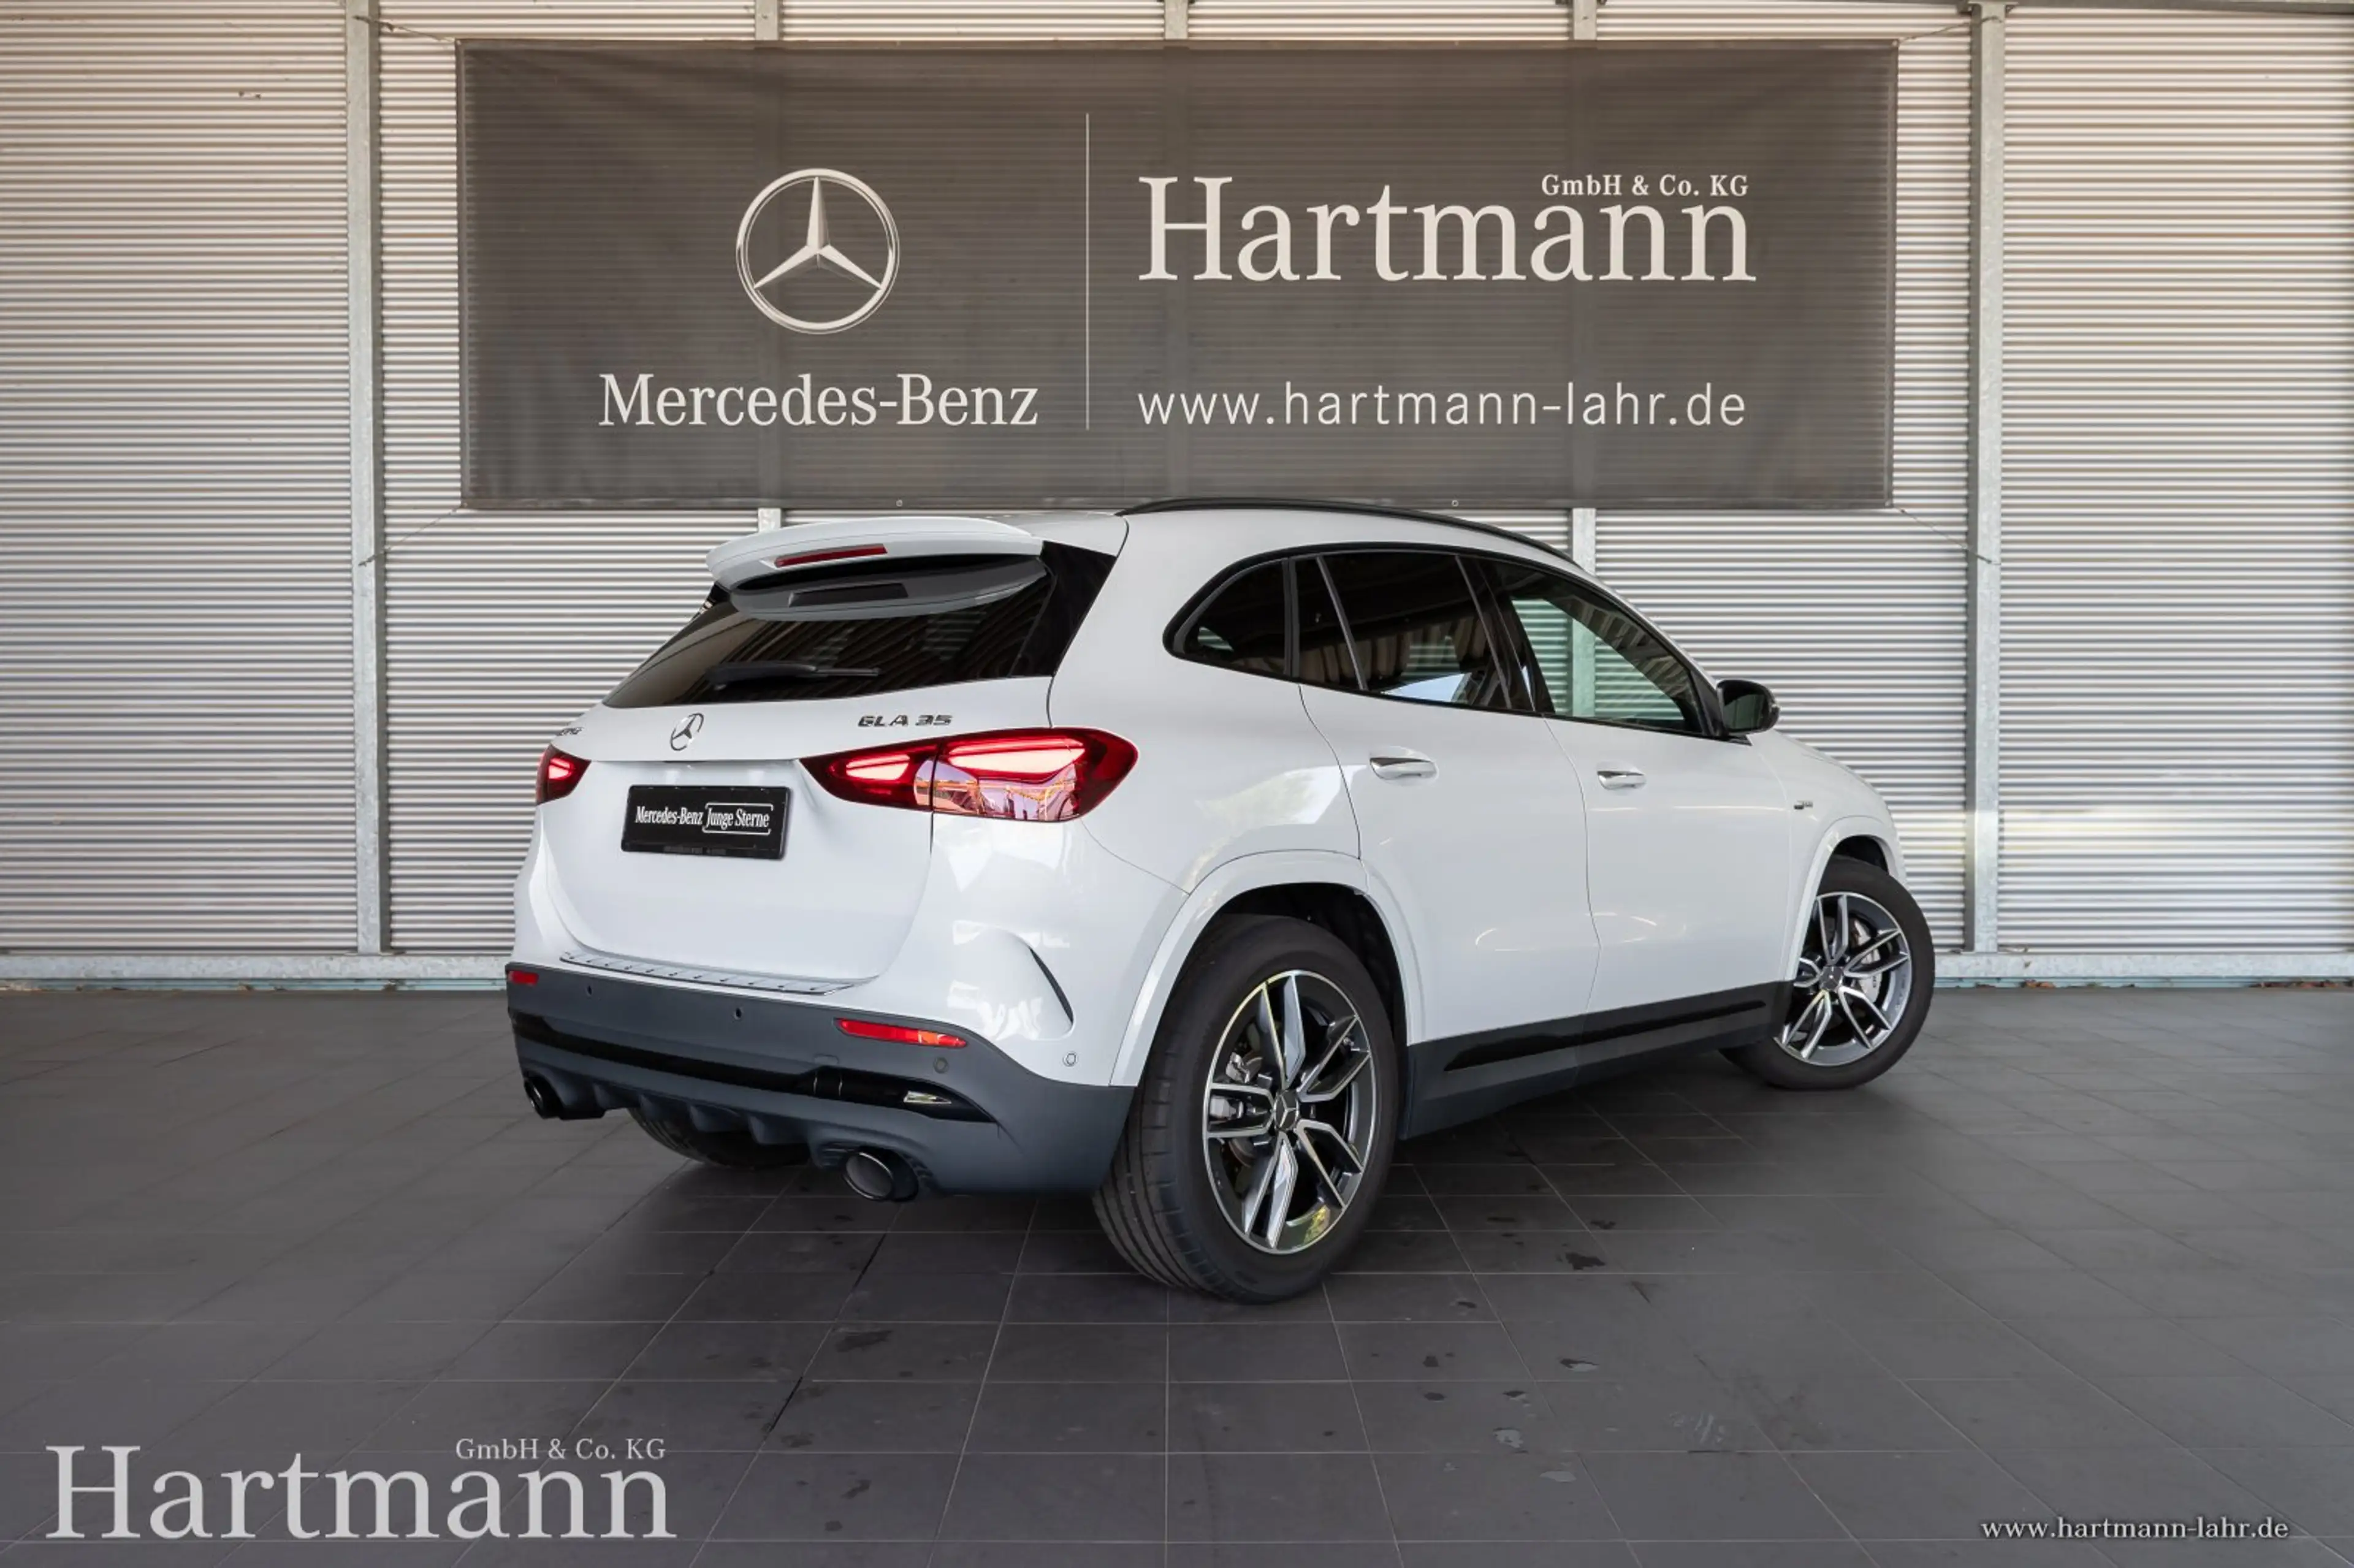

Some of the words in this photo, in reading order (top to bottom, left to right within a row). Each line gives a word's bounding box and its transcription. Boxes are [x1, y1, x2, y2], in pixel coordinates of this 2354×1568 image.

[1541, 174, 1622, 196] GmbH
[1632, 174, 1649, 196] &
[1659, 174, 1700, 197] Co.
[1710, 174, 1748, 197] KG
[1138, 176, 1757, 282] Hartmann
[598, 373, 1038, 426] Mercedes-Benz
[1138, 381, 1745, 426] www.hartmann-lahr.de
[858, 714, 908, 727] GLA
[915, 714, 953, 726] 35
[634, 805, 704, 825] Mercedes-Benz
[706, 807, 734, 830] Junge
[735, 808, 770, 828] Sterne
